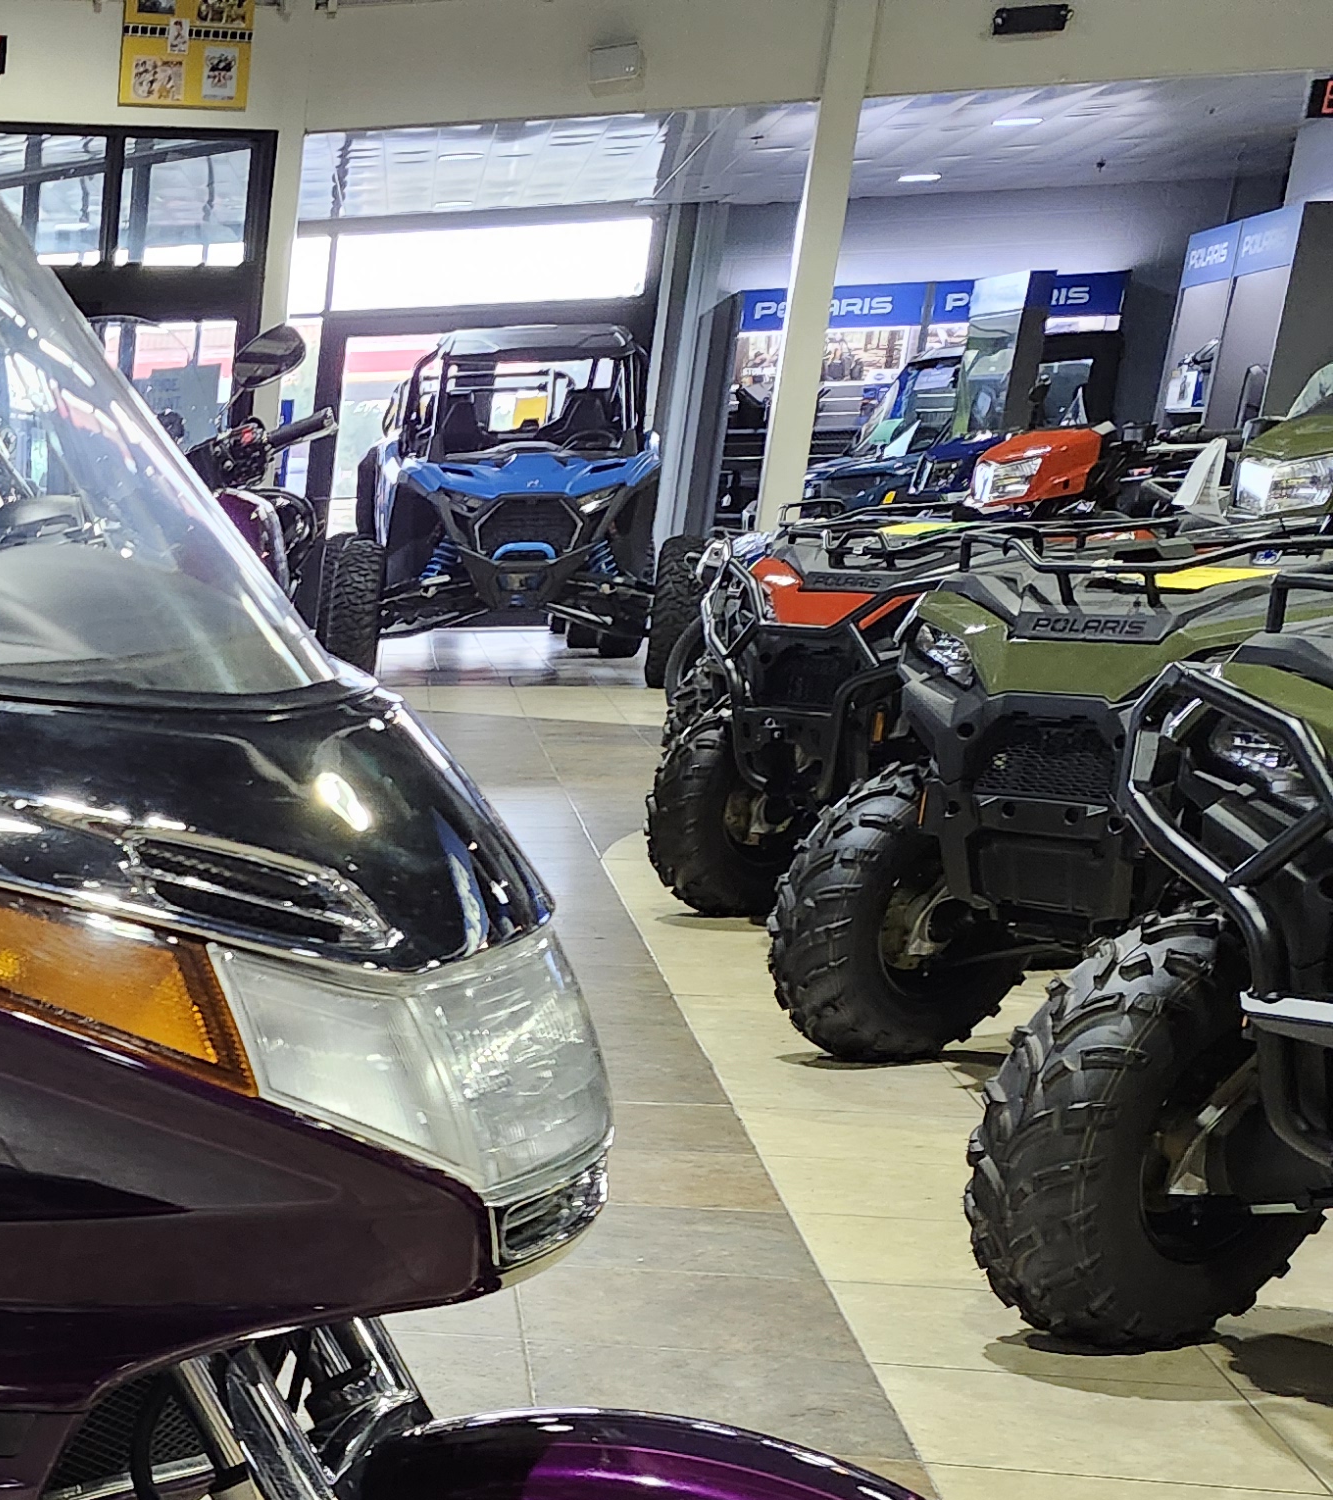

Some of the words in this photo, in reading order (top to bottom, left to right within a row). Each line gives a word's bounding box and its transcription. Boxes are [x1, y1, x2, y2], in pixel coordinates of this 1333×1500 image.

[1187, 241, 1229, 271] POLARIS
[813, 574, 882, 588] POLARIS
[1032, 617, 1147, 635] POLARIS
